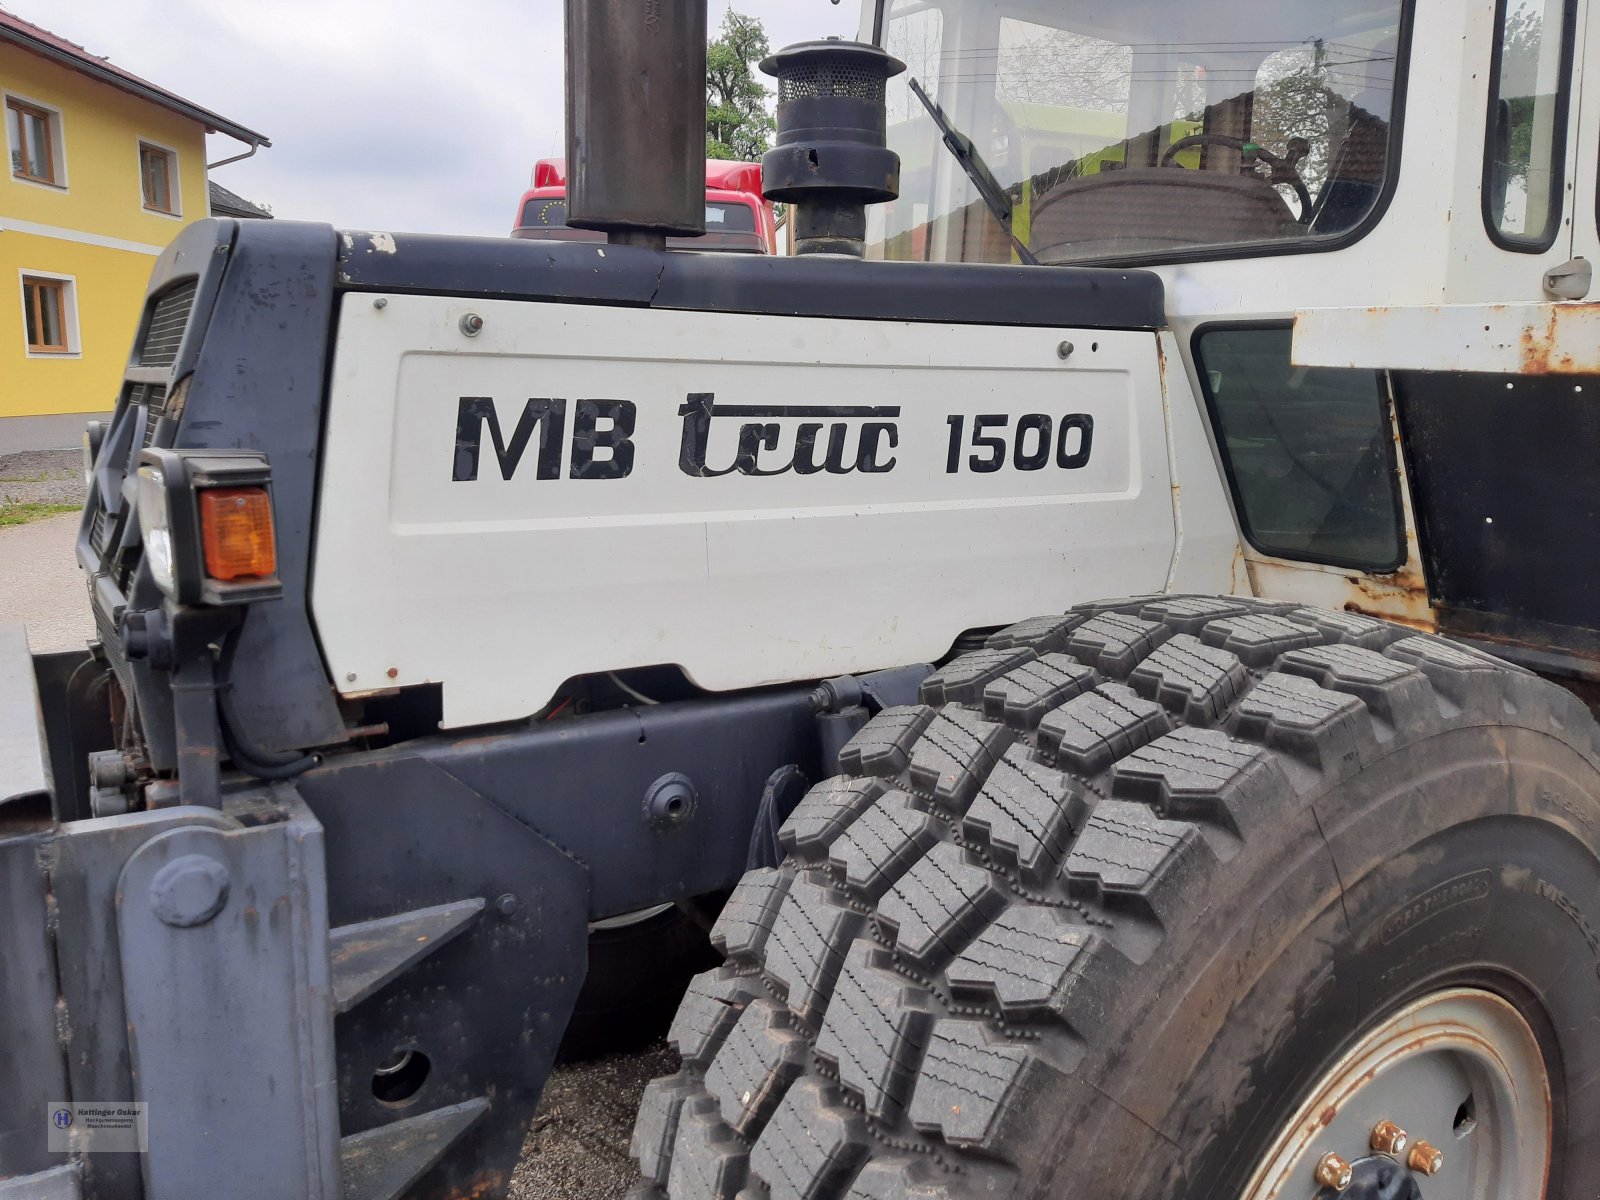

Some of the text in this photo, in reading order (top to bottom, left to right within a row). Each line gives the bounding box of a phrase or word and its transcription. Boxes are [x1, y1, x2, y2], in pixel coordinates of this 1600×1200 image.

[452, 393, 1093, 481] MB trac 1500
